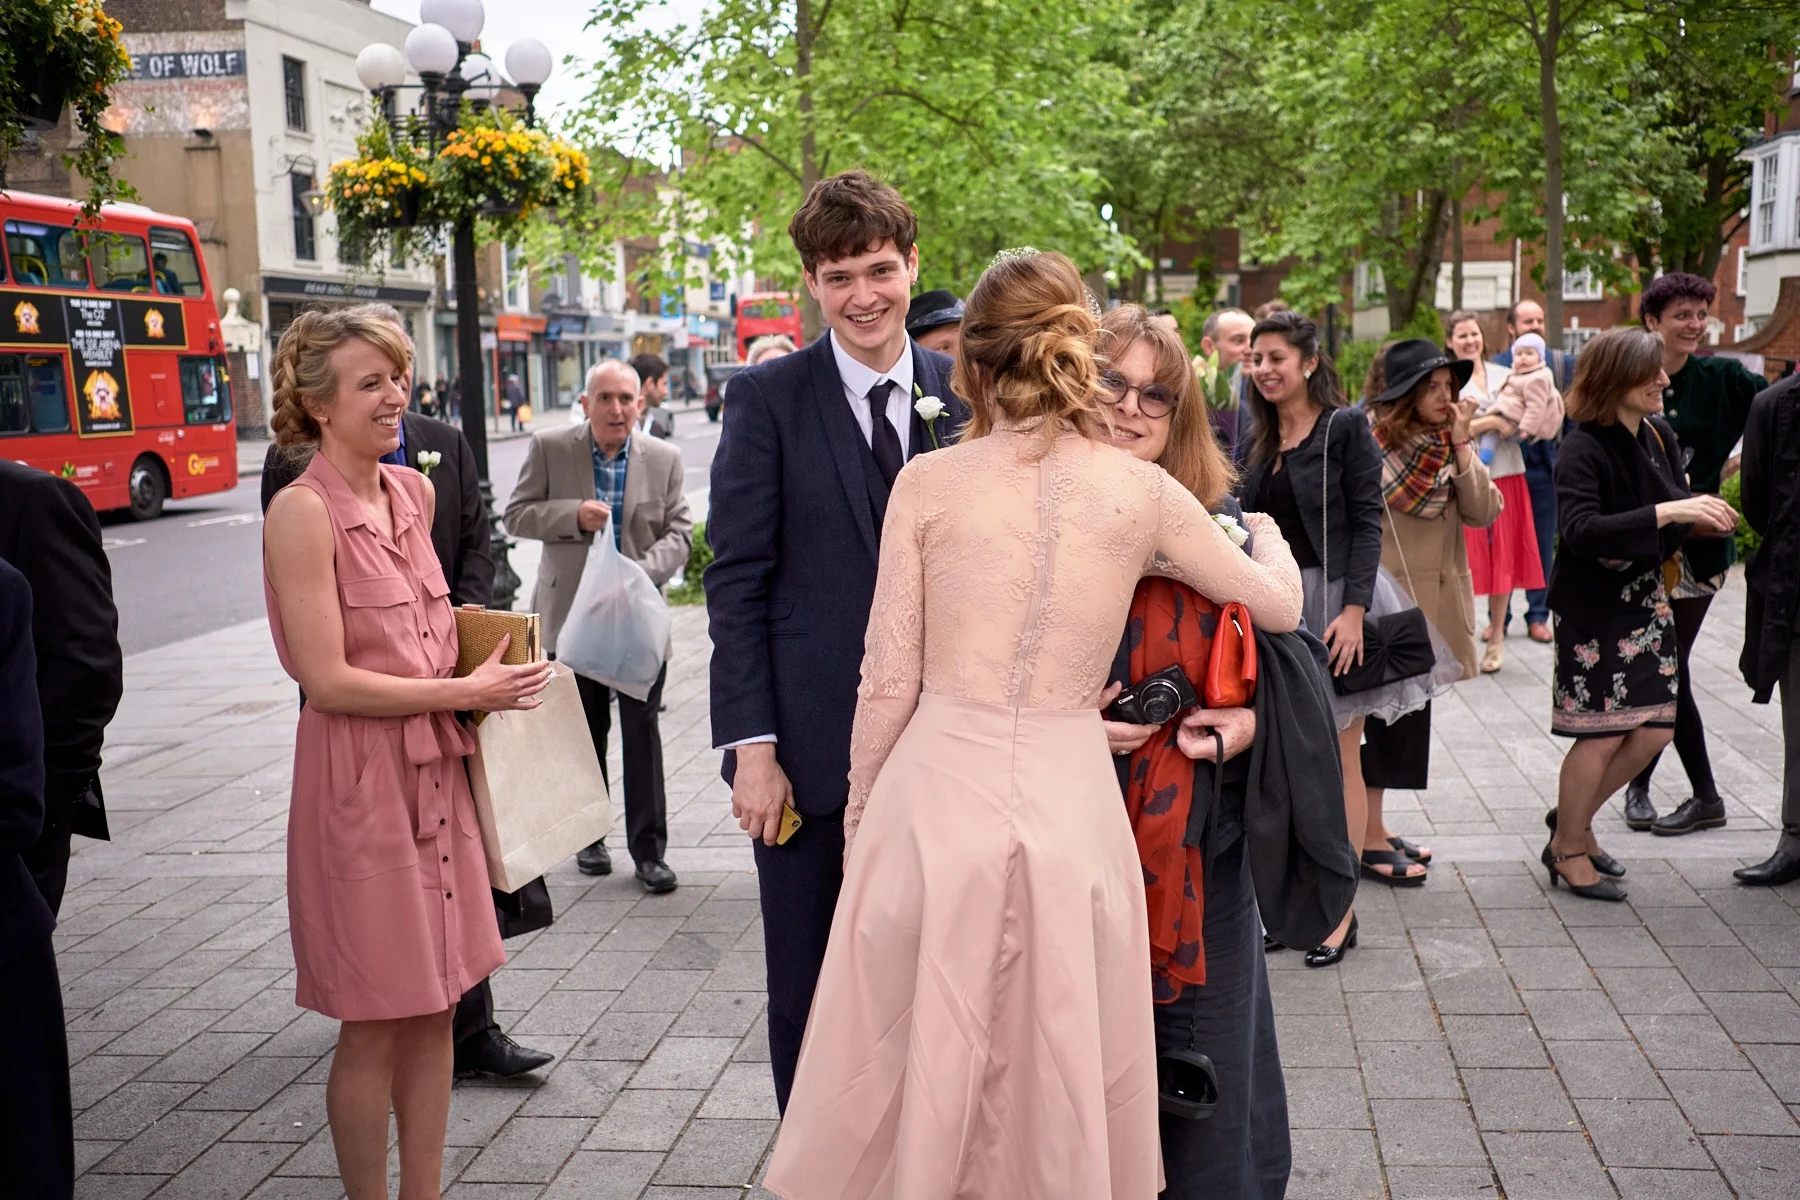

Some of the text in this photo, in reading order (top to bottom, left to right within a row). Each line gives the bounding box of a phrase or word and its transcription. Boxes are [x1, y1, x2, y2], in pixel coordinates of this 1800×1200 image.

[149, 55, 175, 77] OF
[180, 52, 238, 76] WOLF
[79, 307, 94, 320] The
[71, 337, 86, 350] THE
[98, 339, 121, 351] ARENA
[80, 349, 113, 361] WEMBLEY
[1118, 694, 1134, 705] Canon
